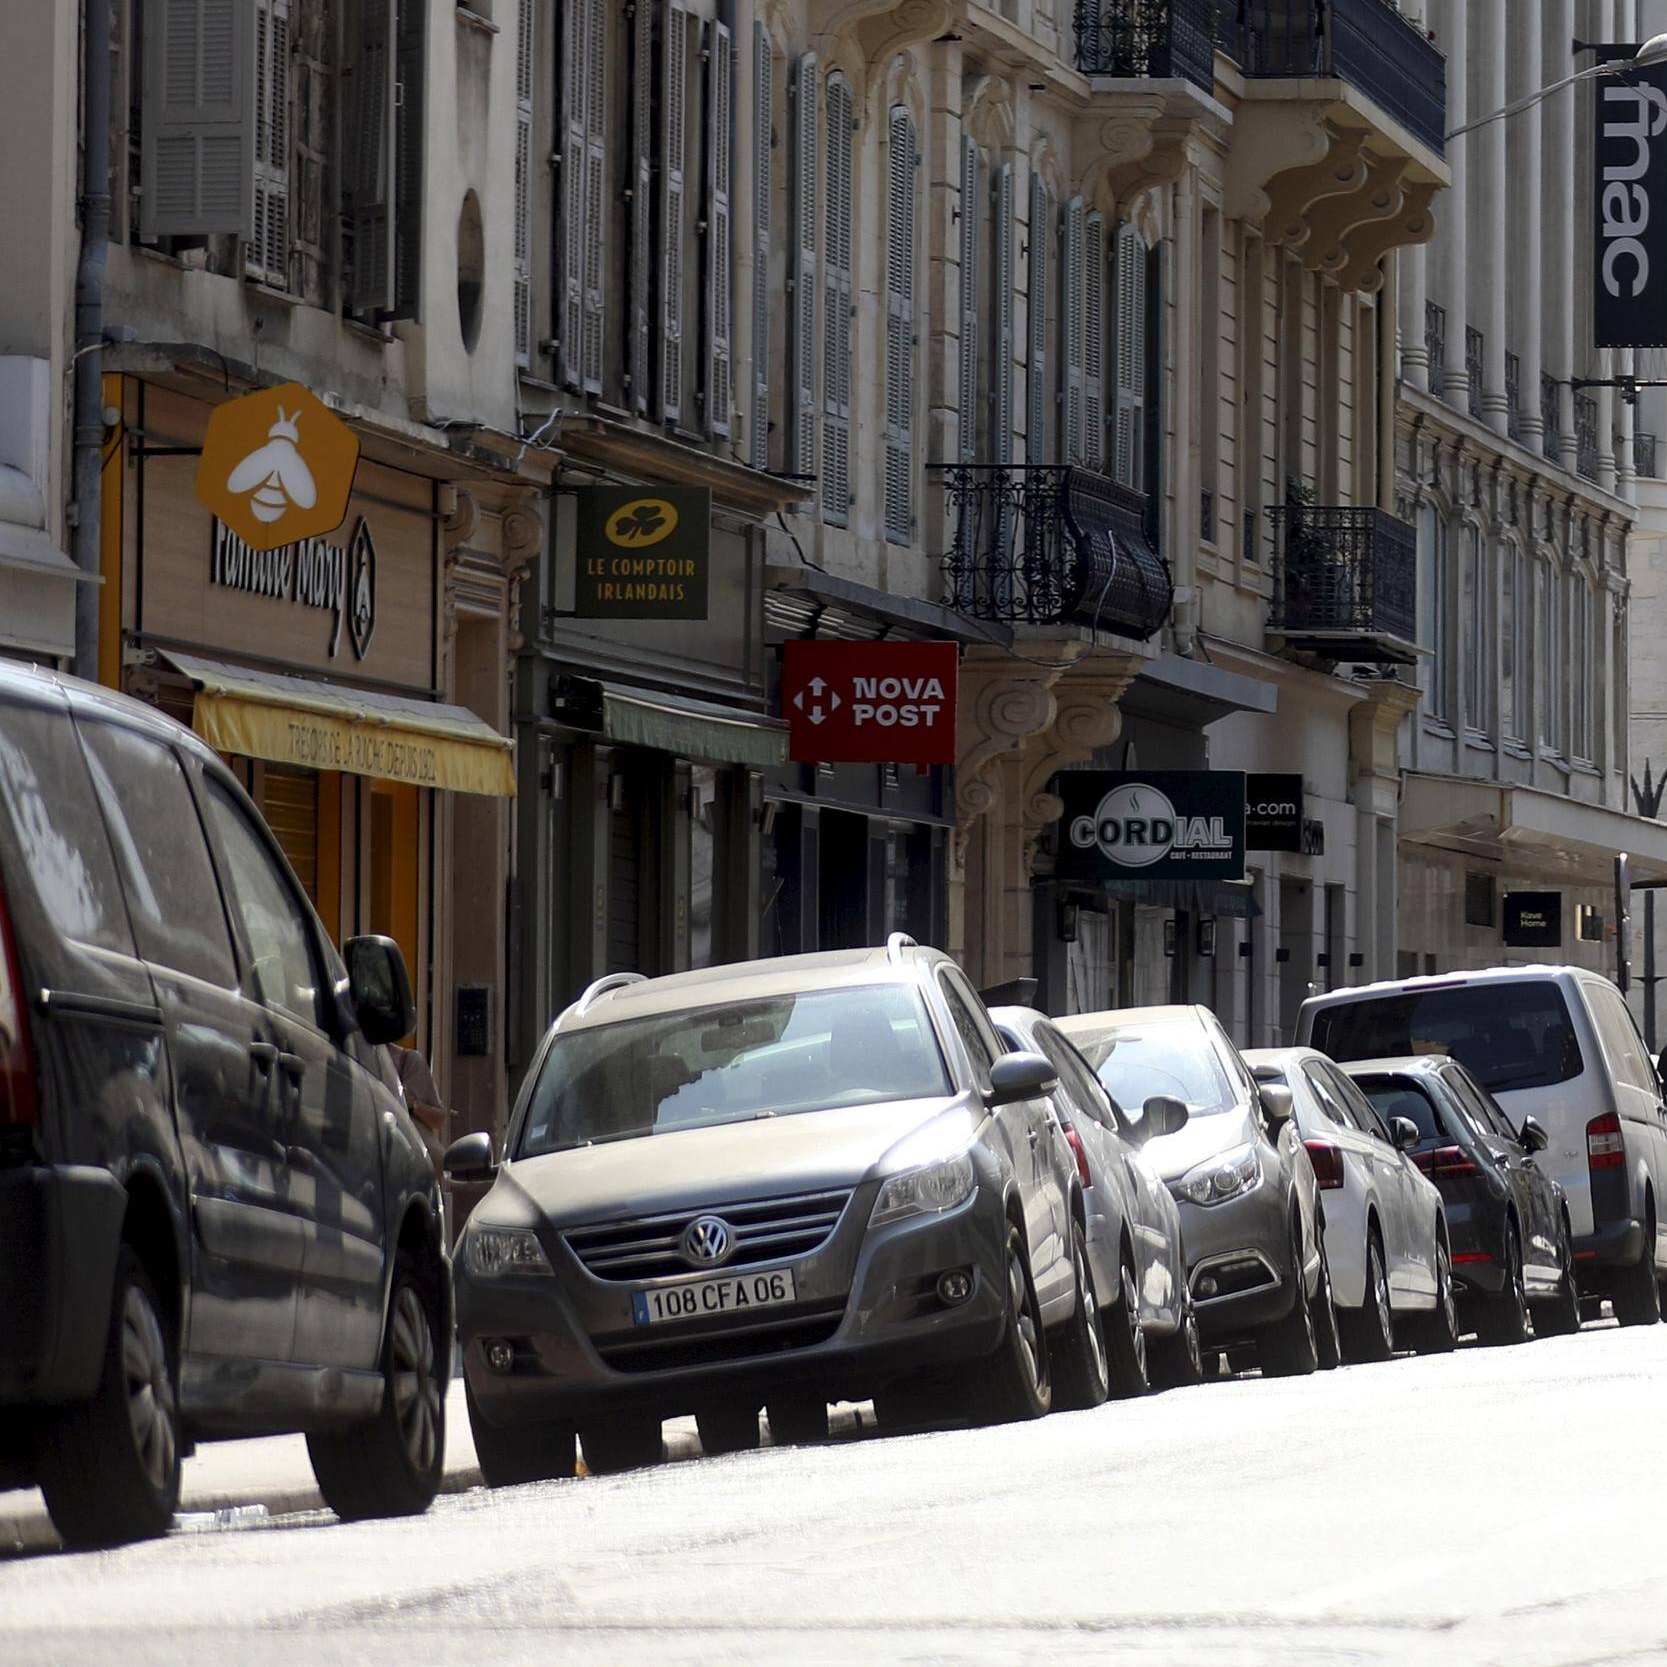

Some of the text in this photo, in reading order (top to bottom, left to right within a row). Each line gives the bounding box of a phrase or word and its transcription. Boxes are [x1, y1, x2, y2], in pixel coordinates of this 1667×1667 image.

[588, 558, 695, 576] LE COMPTOIR
[293, 537, 346, 658] Mary
[598, 582, 685, 600] IRLANDAIS
[852, 677, 946, 700] NOVA
[852, 703, 941, 727] POST
[1069, 815, 1233, 849] CORDIAL
[1190, 850, 1233, 860] RESTAURANT
[1520, 920, 1547, 928] Home
[654, 1287, 698, 1319] 108
[702, 1279, 750, 1311] CFA
[754, 1273, 786, 1304] 06
